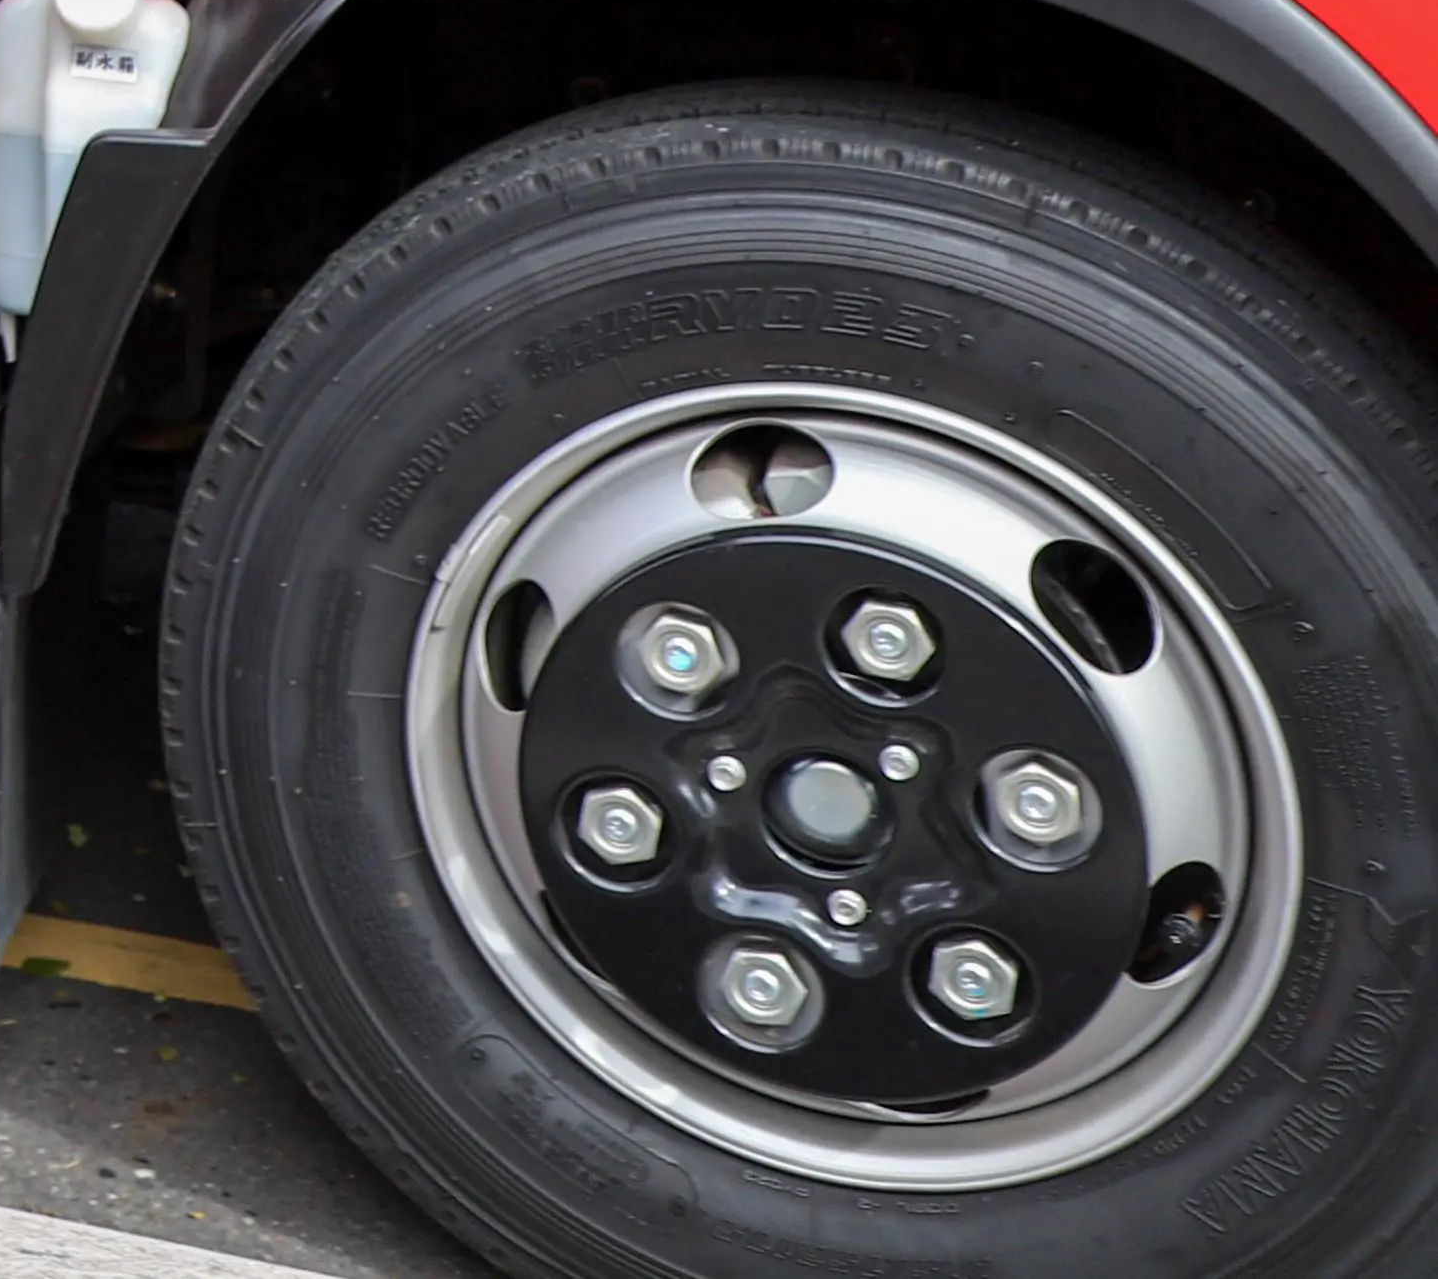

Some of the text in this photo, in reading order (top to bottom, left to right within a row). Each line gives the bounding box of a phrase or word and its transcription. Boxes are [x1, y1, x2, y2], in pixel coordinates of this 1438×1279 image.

[75, 50, 135, 75] 副水箱
[1181, 984, 1414, 1235] YOKOHAMA
